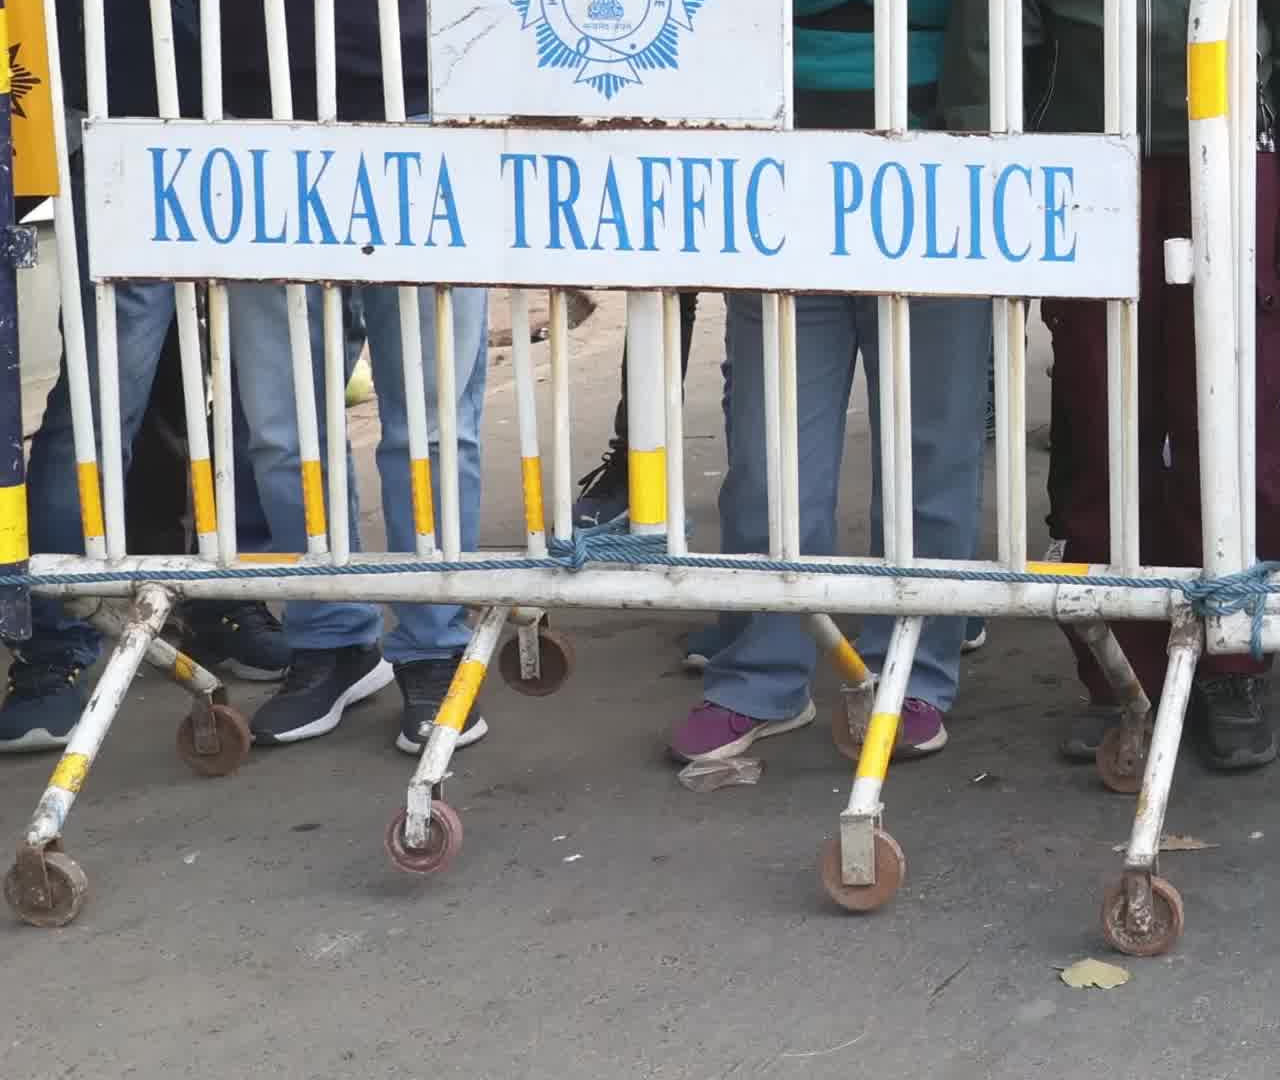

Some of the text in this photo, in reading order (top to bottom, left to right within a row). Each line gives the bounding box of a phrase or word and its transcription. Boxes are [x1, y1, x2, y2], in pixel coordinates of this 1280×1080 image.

[147, 146, 1078, 264] KOLKATA TRAFFIC POLICE
